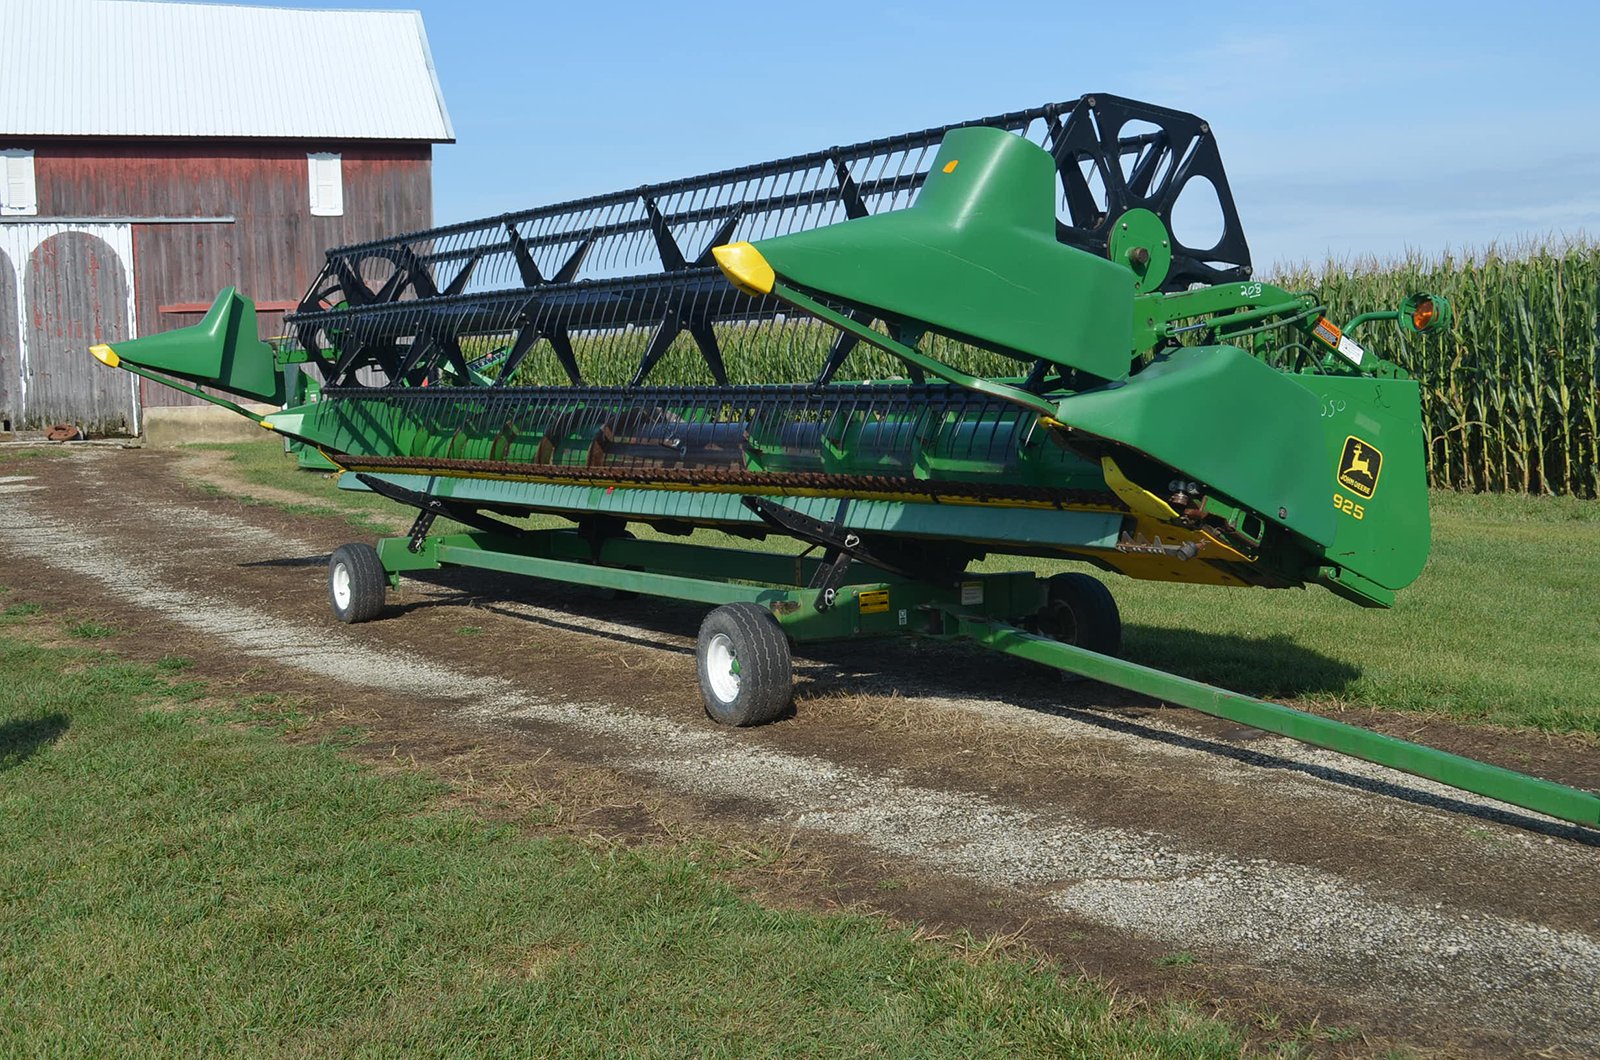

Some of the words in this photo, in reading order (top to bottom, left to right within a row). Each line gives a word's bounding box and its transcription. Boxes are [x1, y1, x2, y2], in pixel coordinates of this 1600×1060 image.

[1340, 474, 1354, 486] JOHN
[1353, 480, 1371, 495] DEERE
[1333, 493, 1365, 520] 925
